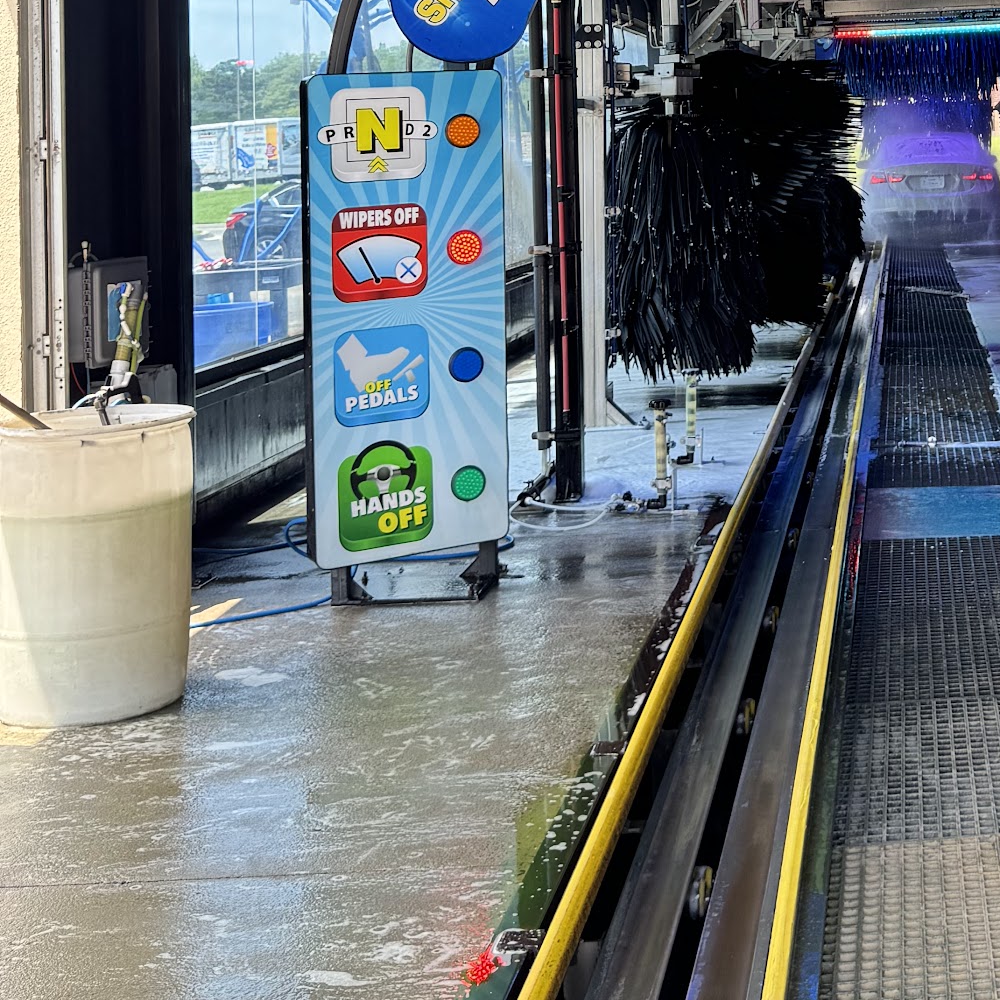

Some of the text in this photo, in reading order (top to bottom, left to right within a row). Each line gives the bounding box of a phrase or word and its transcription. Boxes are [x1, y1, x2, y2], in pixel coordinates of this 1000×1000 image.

[325, 107, 431, 154] P R N D 2
[338, 206, 420, 230] WIPERS OFF
[344, 384, 420, 413] PEDALS
[364, 378, 392, 393] OFF
[350, 485, 428, 519] HANDS
[377, 503, 428, 535] OFF
